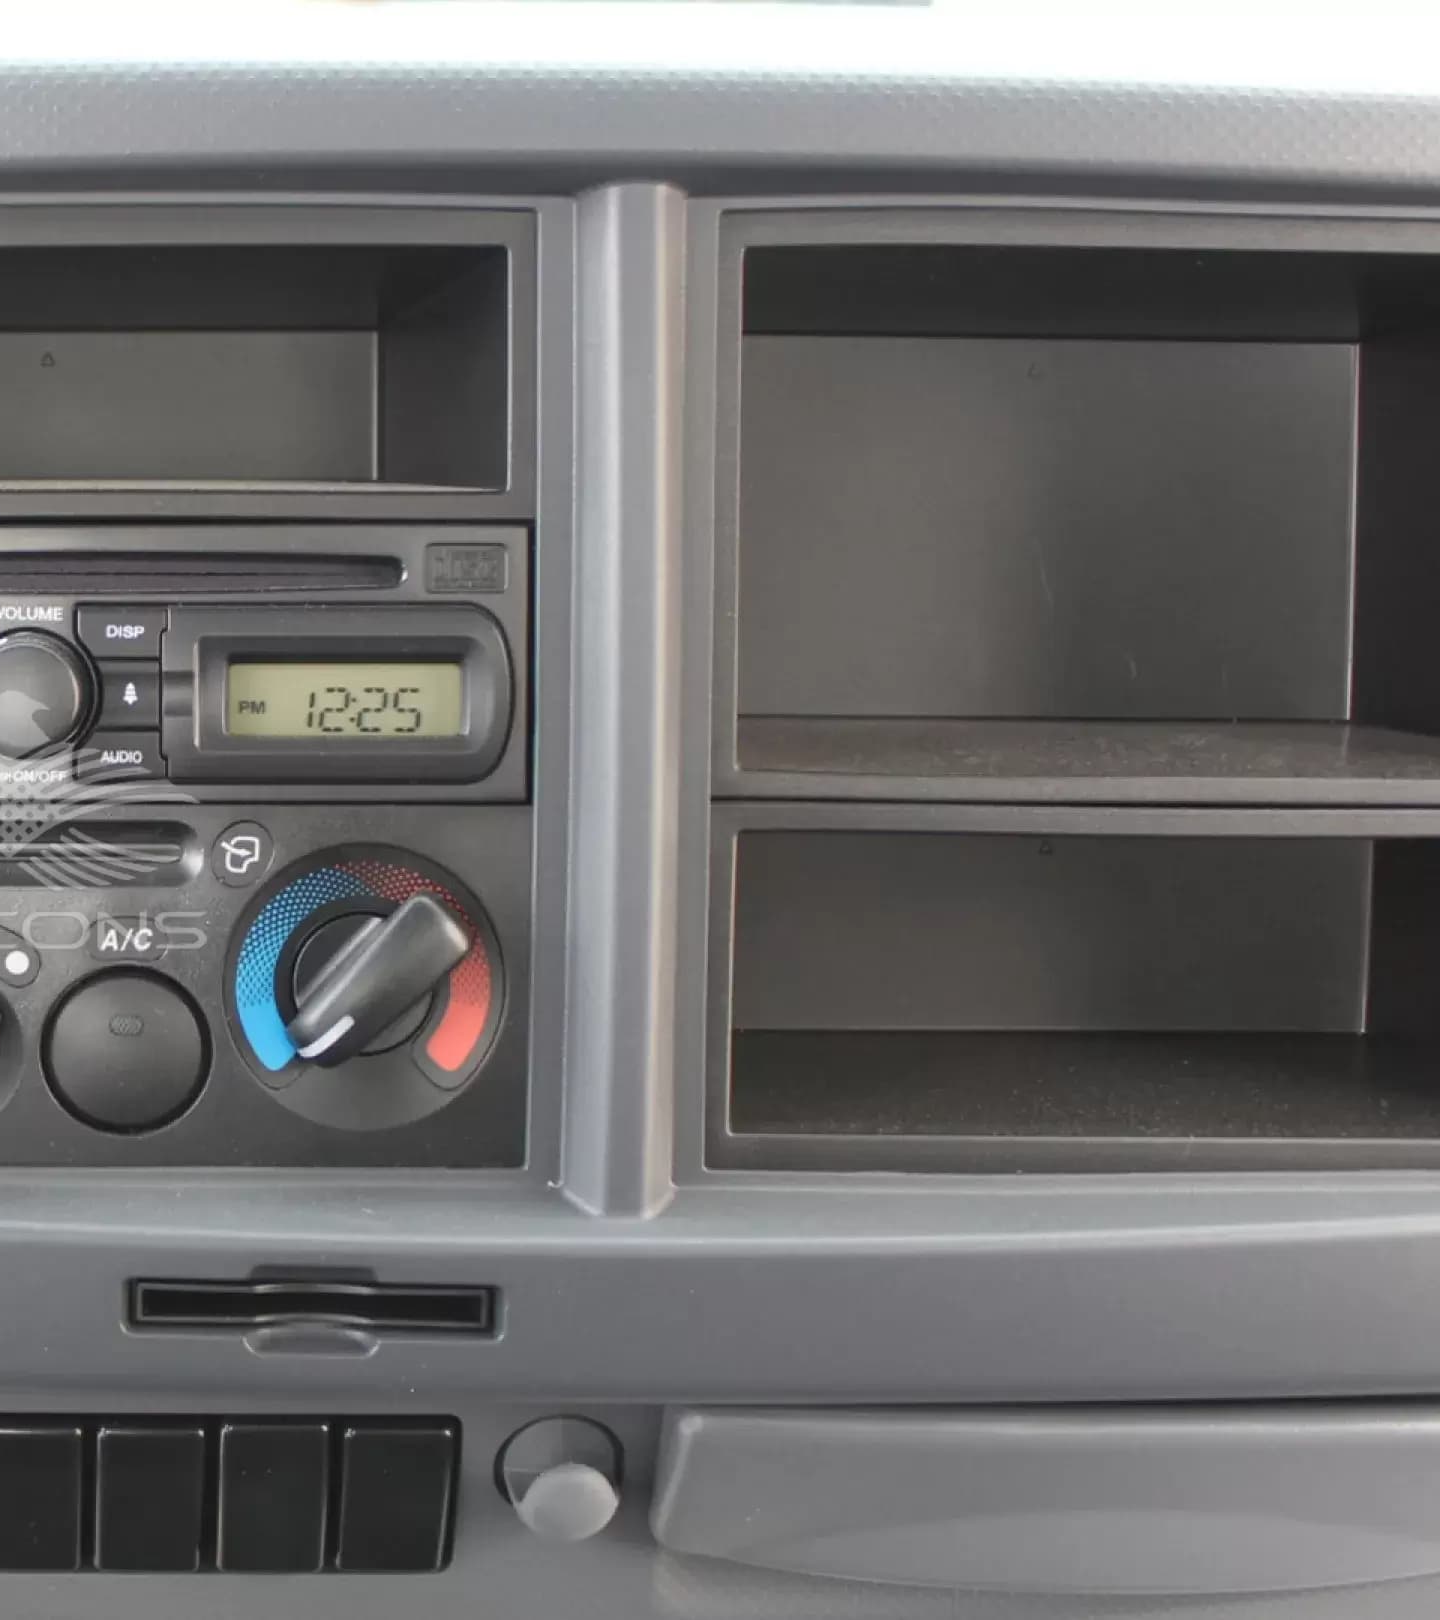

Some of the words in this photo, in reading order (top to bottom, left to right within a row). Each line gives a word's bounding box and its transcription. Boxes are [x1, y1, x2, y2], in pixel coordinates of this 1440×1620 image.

[106, 624, 145, 639] DISP
[238, 700, 266, 715] PM
[307, 687, 421, 733] 12:25
[99, 750, 143, 764] AUDIO
[13, 770, 68, 782] ON/OFF
[99, 927, 153, 952] A/C
